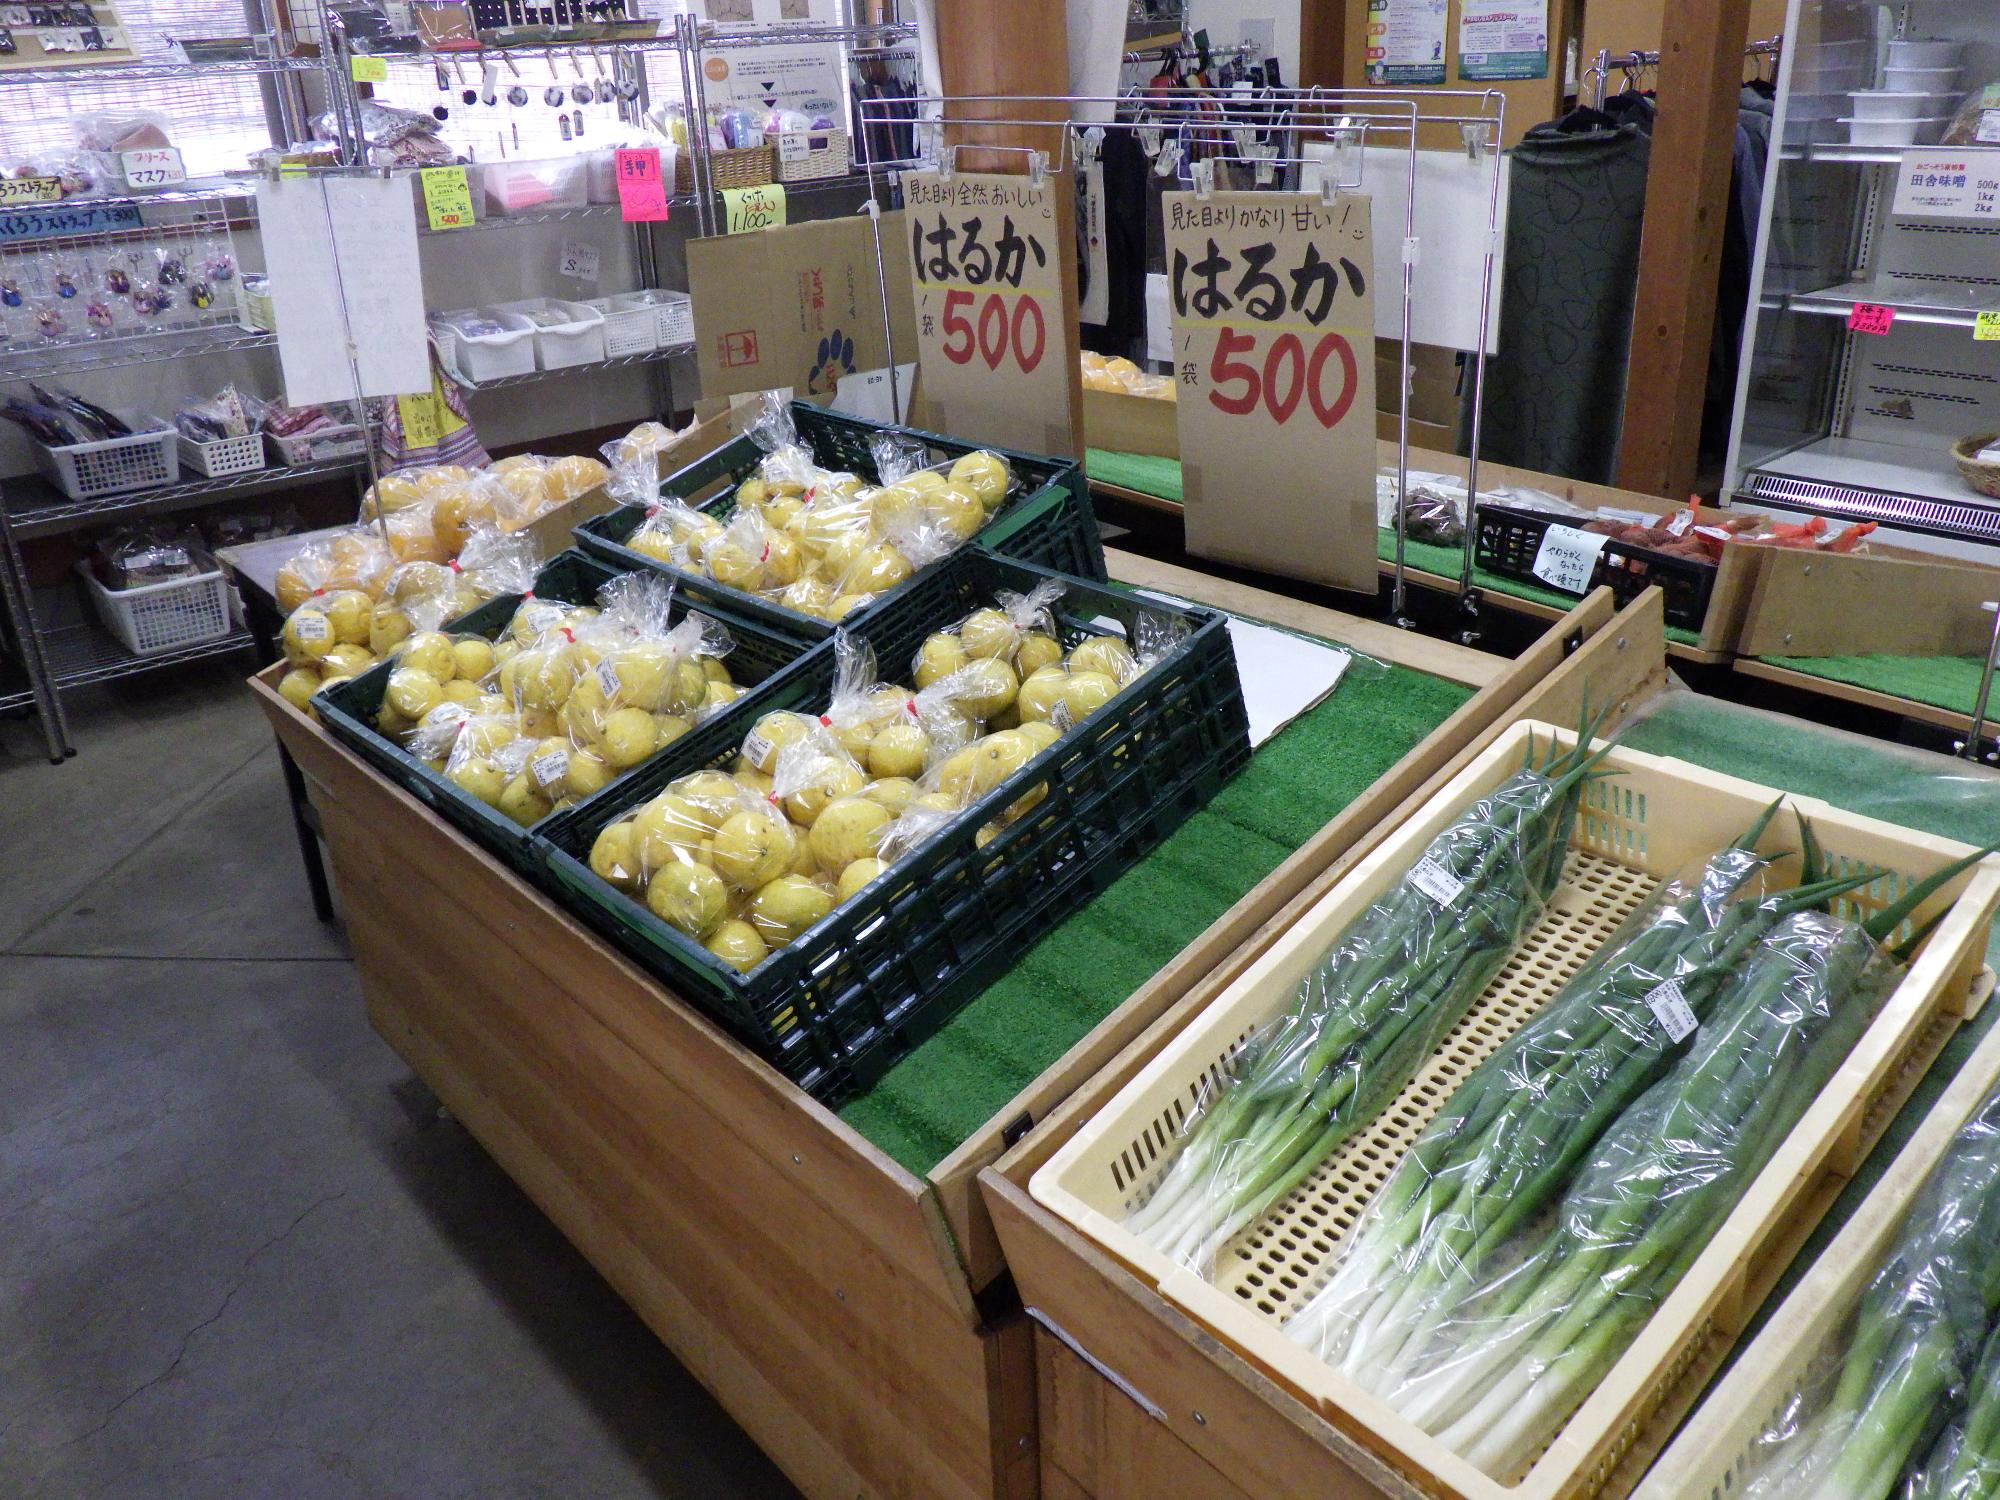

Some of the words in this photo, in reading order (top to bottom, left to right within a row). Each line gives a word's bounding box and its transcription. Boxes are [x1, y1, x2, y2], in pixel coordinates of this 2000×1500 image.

[130, 169, 166, 183] マスク
[1910, 174, 1966, 188] 田舎味噌
[1977, 180, 1999, 190] 500g
[1978, 191, 1995, 201] 1kg
[1974, 203, 1993, 212] 2kg
[912, 211, 1046, 288] はるか
[1173, 238, 1366, 327] はるか
[943, 288, 1047, 374] 500
[1208, 326, 1358, 430] 500
[1545, 546, 1581, 561] やわらかく
